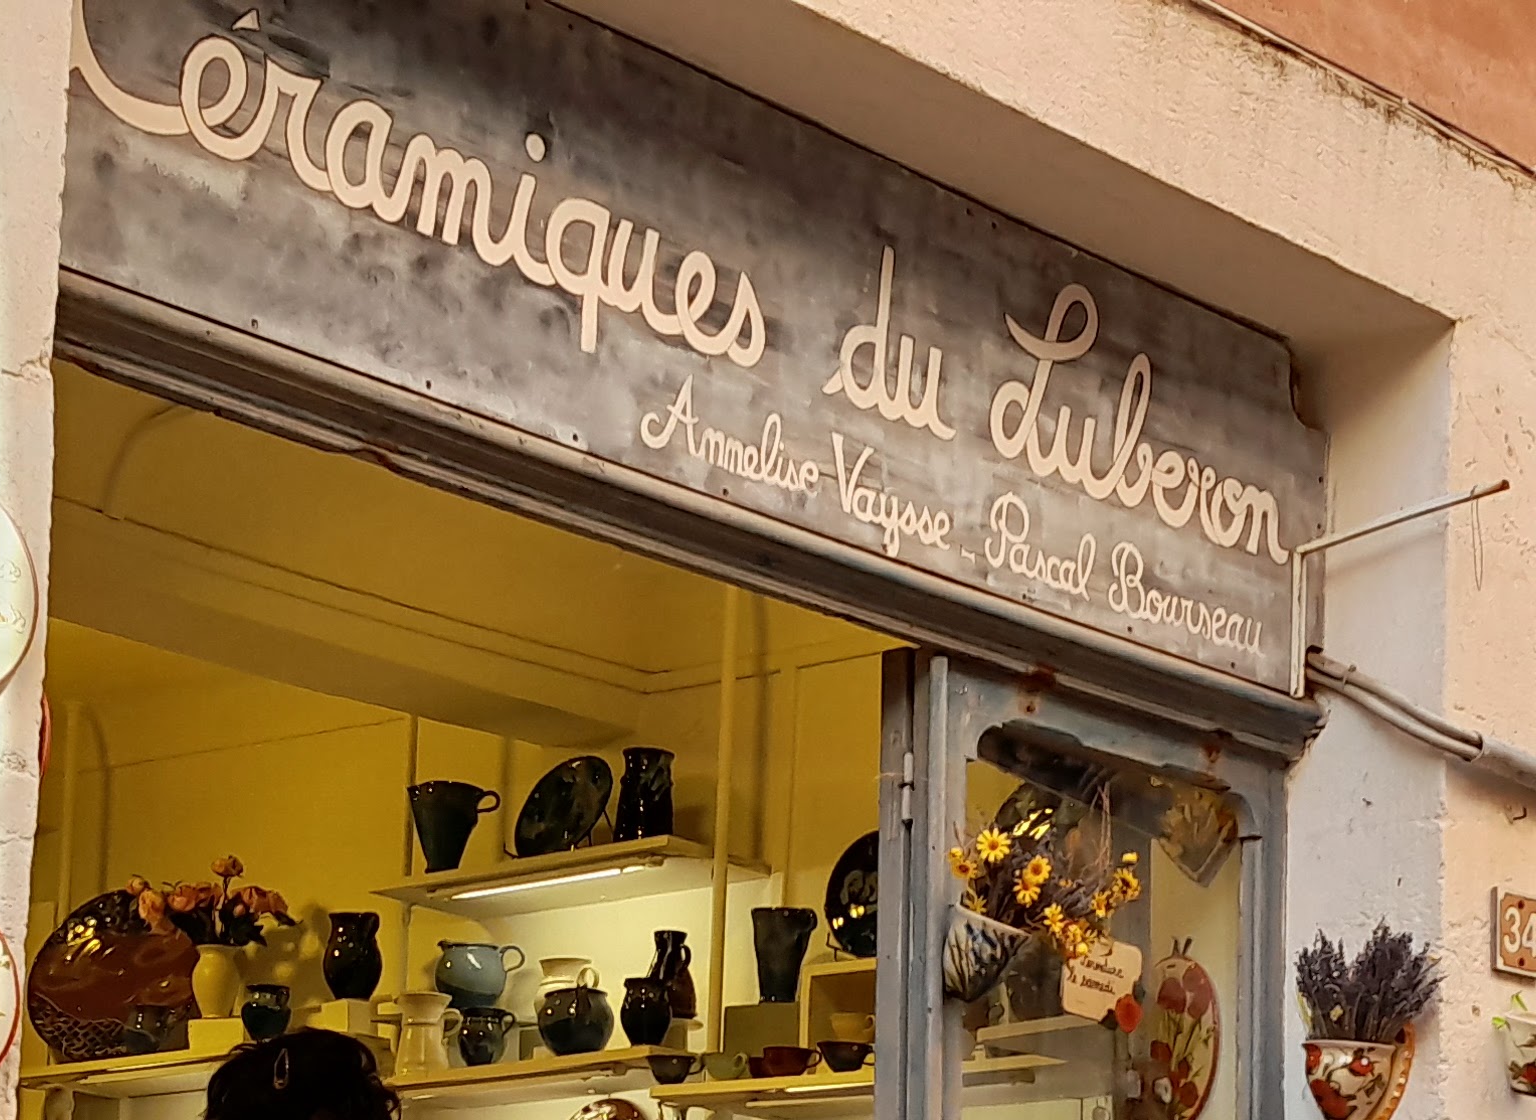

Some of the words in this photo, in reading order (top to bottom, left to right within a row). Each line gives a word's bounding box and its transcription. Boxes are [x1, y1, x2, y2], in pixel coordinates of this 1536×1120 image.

[641, 374, 818, 497] Annelise
[831, 432, 951, 558] Vaysse
[984, 491, 1096, 602] Pascal
[1109, 541, 1265, 658] Bourseau
[822, 246, 956, 441] du
[990, 282, 1290, 565] Luberon
